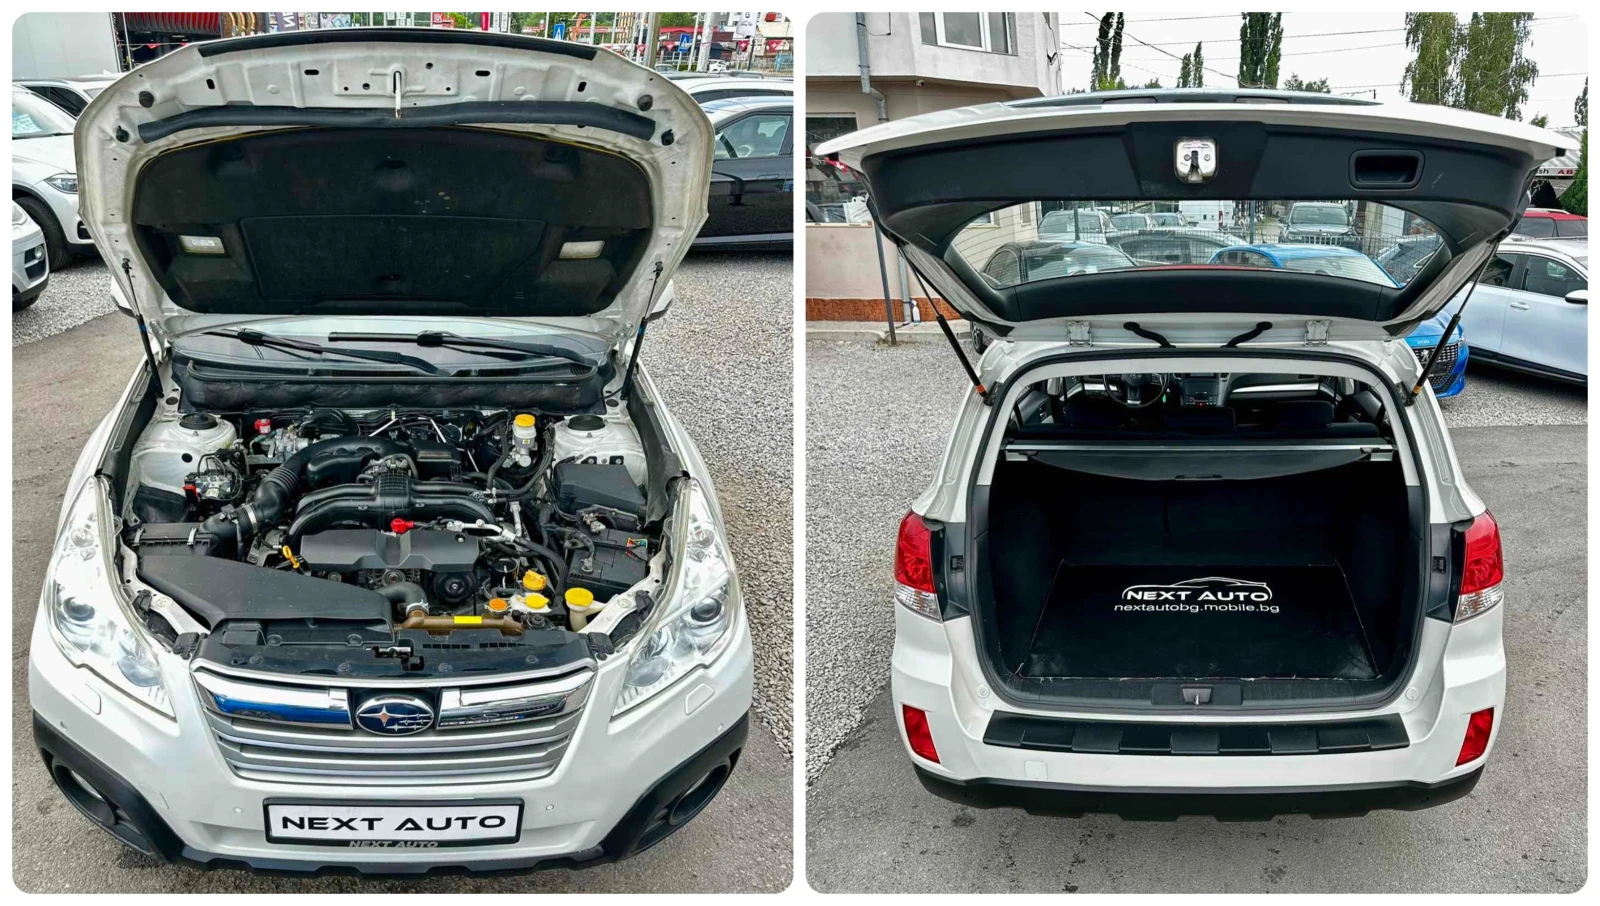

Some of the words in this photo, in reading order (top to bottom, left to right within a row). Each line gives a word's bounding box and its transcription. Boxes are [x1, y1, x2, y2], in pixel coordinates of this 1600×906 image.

[1126, 591, 1192, 600] NEXT
[1197, 591, 1269, 601] AUTO
[1114, 604, 1280, 613] nextautobg.mobile.bg
[281, 816, 384, 830] NEXT
[394, 815, 506, 831] AUTO
[348, 840, 393, 848] NEXT
